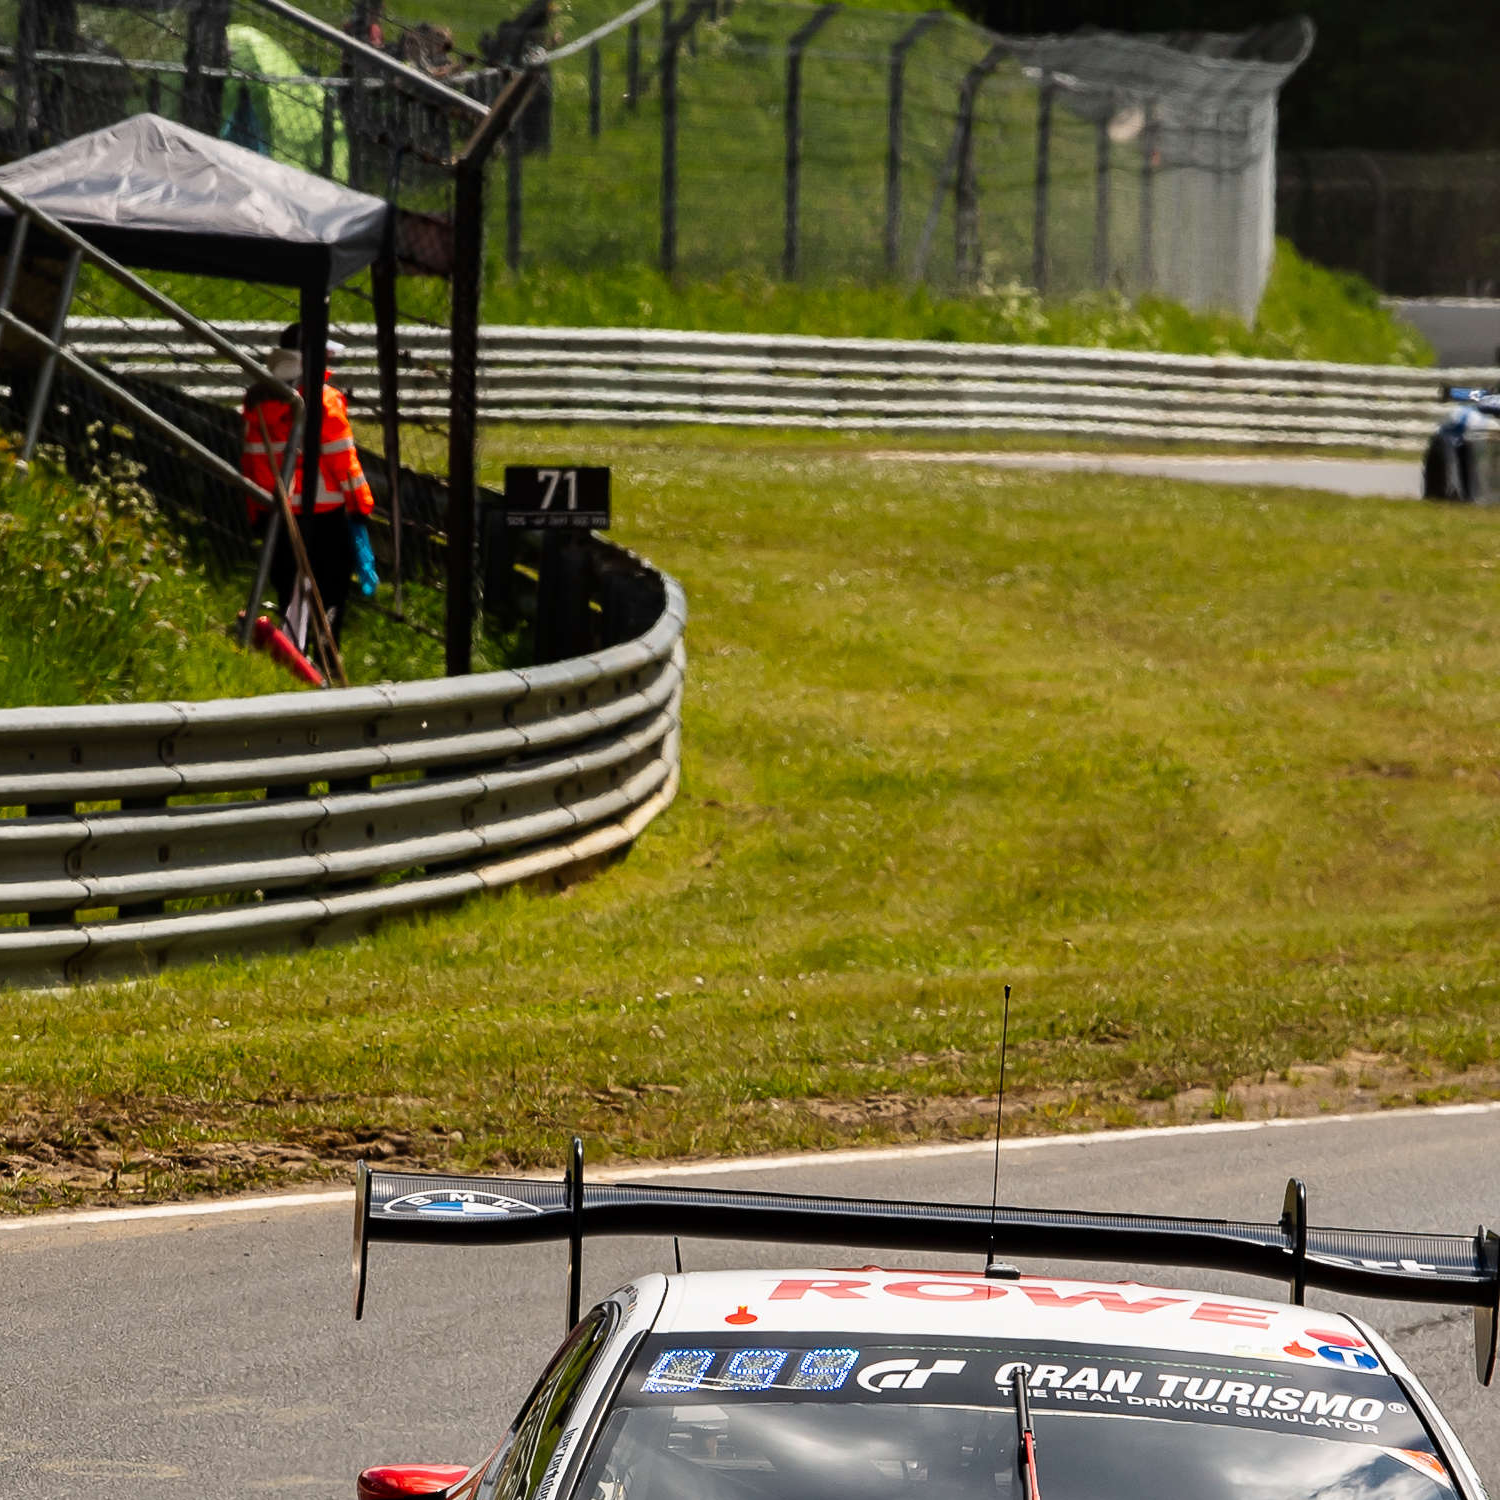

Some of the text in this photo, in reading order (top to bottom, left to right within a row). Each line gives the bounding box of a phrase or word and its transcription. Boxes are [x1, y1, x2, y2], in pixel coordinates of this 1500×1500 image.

[537, 470, 577, 510] 71
[767, 1278, 1279, 1330] ROWE
[994, 1361, 1143, 1395] GRAN
[1055, 1390, 1121, 1404] REAL
[1126, 1396, 1229, 1414] DRIVING
[1235, 1404, 1380, 1435] SIMULATOR
